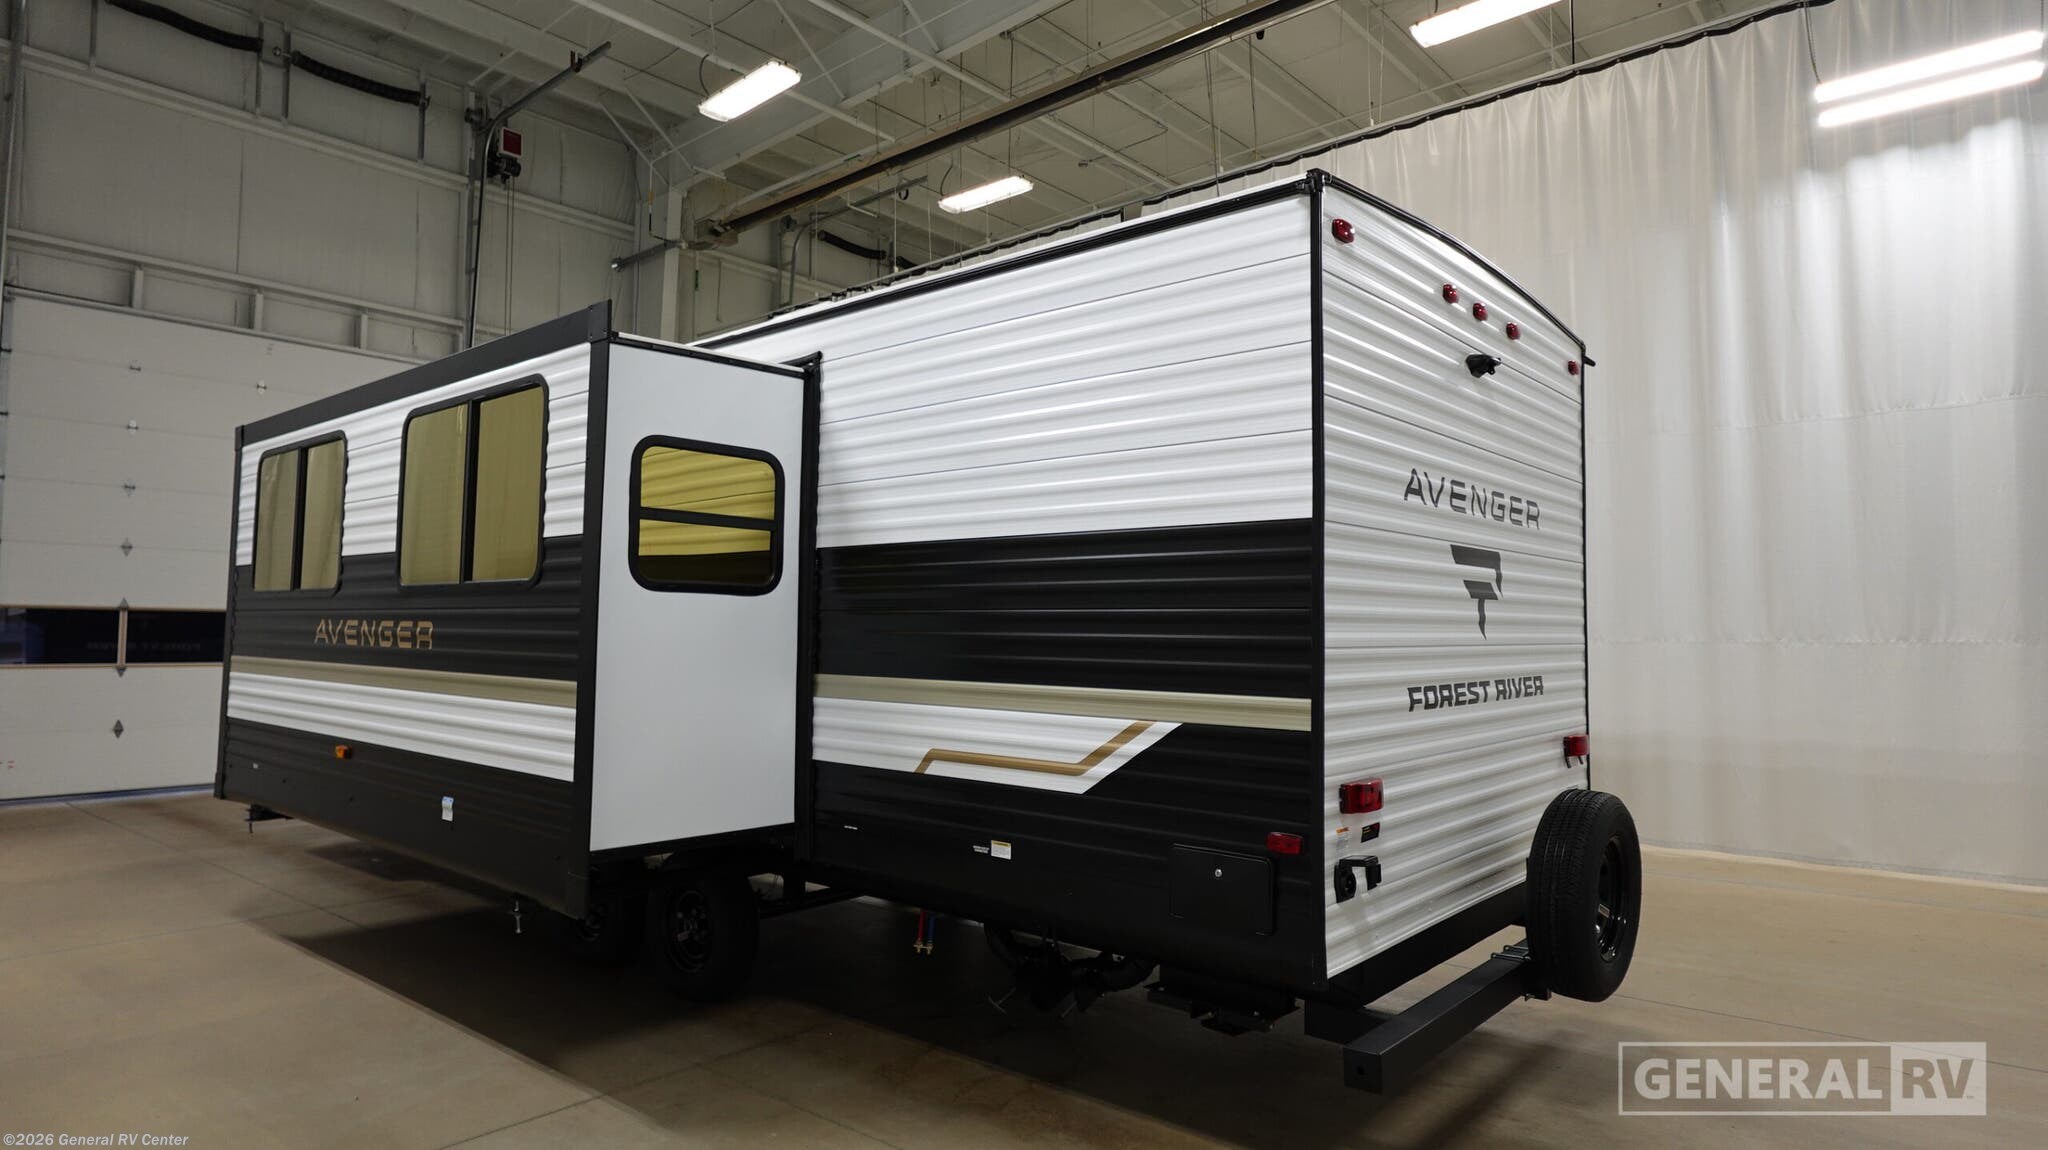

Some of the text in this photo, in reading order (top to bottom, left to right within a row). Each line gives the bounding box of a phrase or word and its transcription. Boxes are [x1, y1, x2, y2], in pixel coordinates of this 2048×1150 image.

[1404, 468, 1541, 530] AVENGER
[314, 619, 434, 651] AVENGER
[1407, 675, 1545, 712] FOREST RIVER
